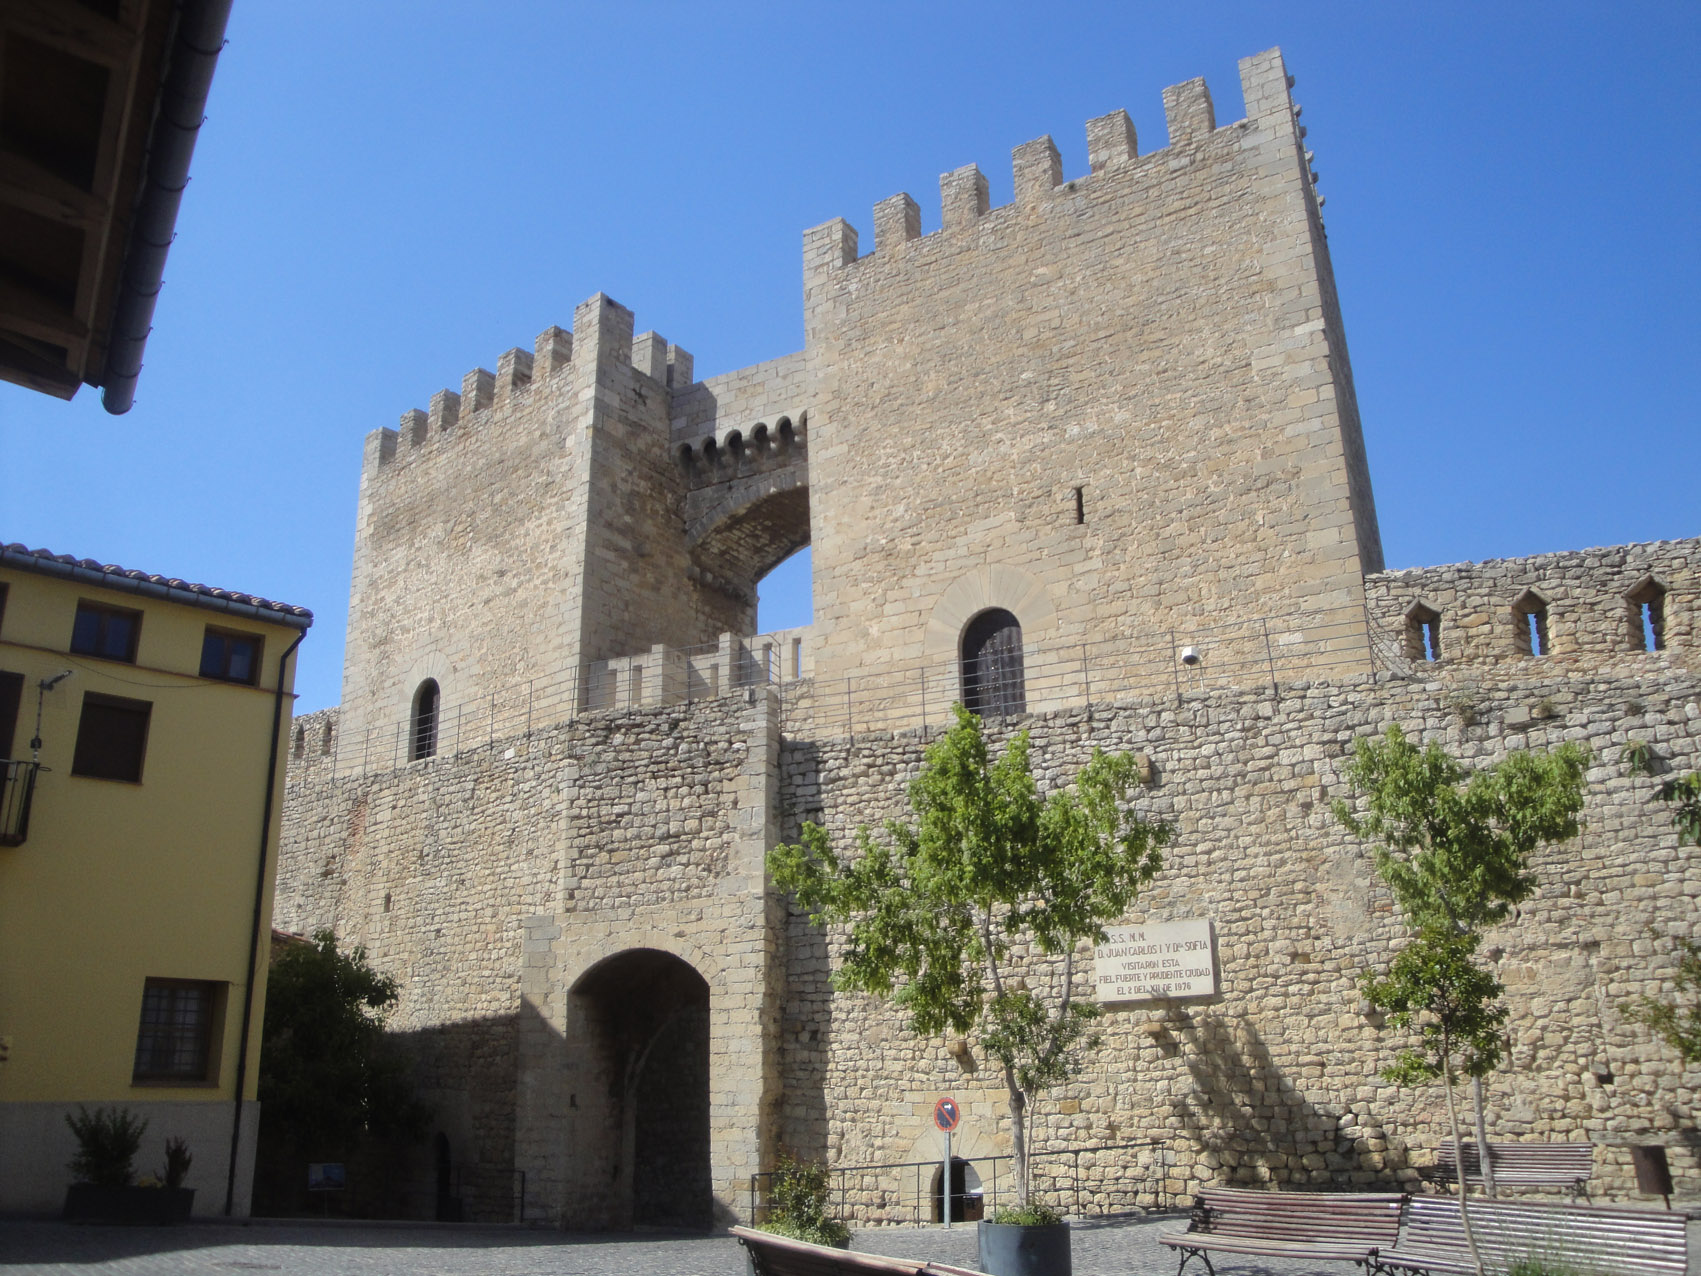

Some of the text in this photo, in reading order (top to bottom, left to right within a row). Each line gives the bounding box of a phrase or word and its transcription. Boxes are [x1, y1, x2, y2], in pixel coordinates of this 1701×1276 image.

[1106, 947, 1127, 958] JUAN
[1128, 945, 1157, 956] CARLOS
[1121, 958, 1180, 970] VISITARON ESTA
[1115, 973, 1142, 983] FUERTE
[1149, 969, 1184, 980] PRUDENTE
[1185, 968, 1210, 977] CIUDAD
[1117, 986, 1126, 995] EL
[1127, 986, 1132, 994] 2
[1134, 985, 1146, 994] DEL
[1163, 983, 1172, 992] DE
[1174, 982, 1191, 991] 1976
